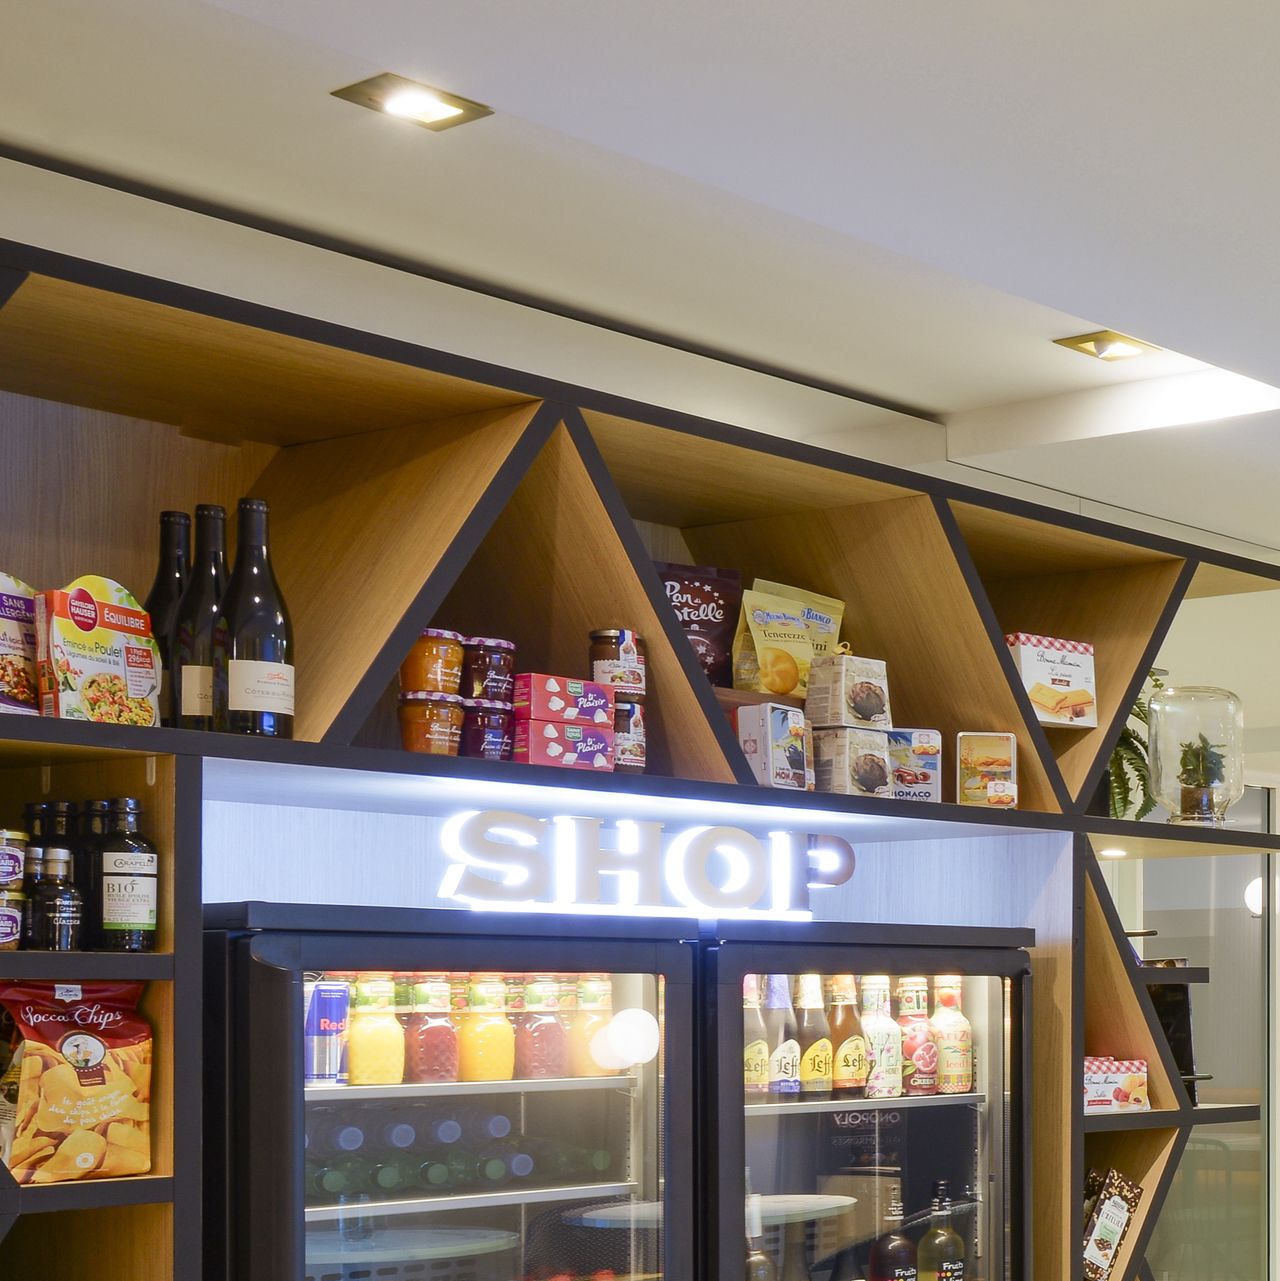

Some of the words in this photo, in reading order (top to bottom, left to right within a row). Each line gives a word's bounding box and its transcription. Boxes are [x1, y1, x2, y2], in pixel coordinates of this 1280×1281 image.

[3, 596, 25, 609] SANS
[71, 606, 96, 618] HAUSER
[104, 608, 145, 630] ÉQUILIBRE
[95, 642, 122, 658] Poulet
[577, 696, 606, 708] Plaisir
[576, 742, 605, 753] Plaisir
[438, 809, 856, 913] SHOP
[107, 883, 134, 893] BIO
[74, 1003, 124, 1030] Chips
[320, 1018, 346, 1031] Red
[744, 1057, 769, 1076] Leff
[776, 1055, 800, 1078] Leff
[809, 1054, 832, 1076] Leff
[841, 1052, 866, 1070] Leff
